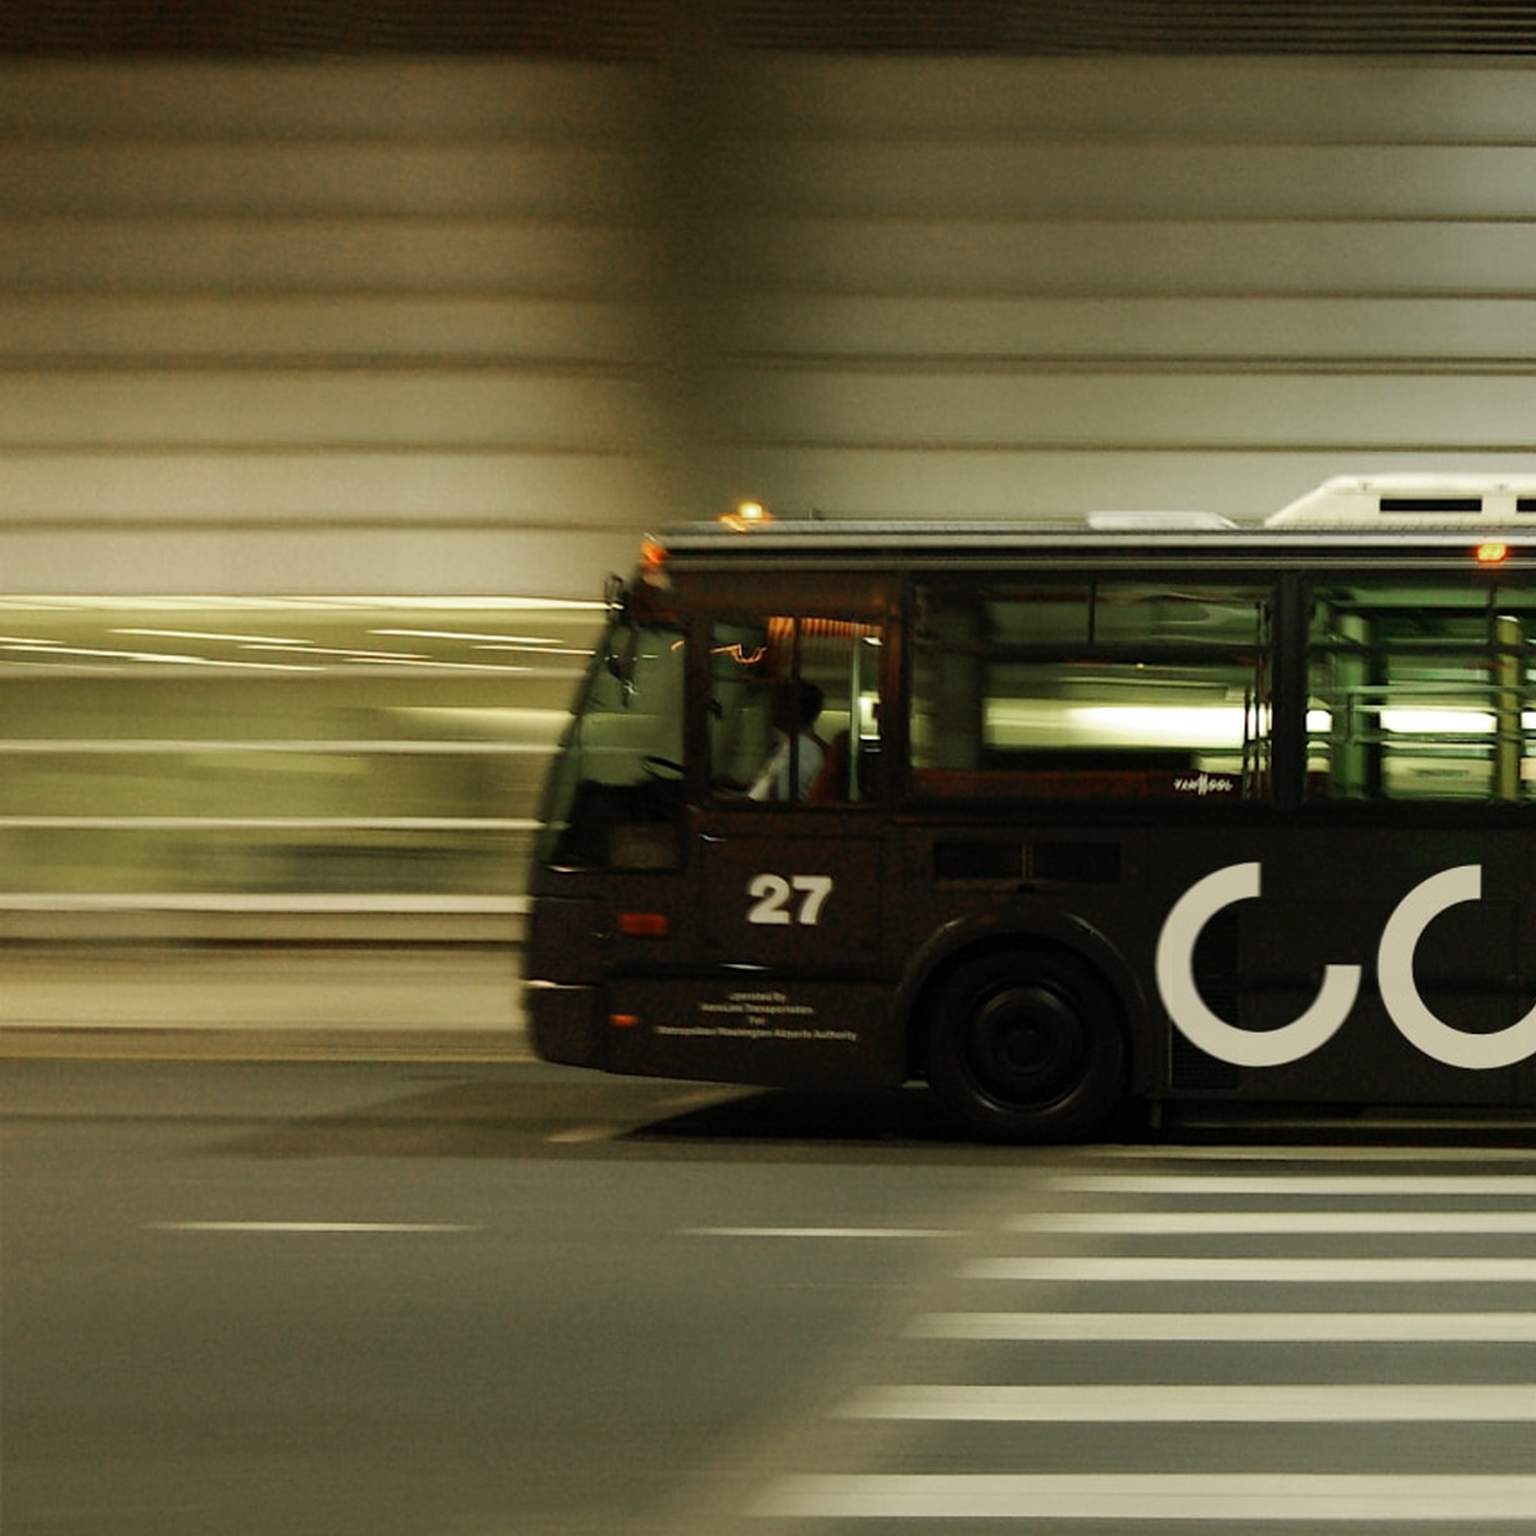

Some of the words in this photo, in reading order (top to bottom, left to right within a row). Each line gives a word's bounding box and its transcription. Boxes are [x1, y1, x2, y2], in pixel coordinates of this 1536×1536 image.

[747, 873, 832, 925] 27
[773, 1028, 812, 1040] Airports
[813, 1029, 856, 1041] Authority
